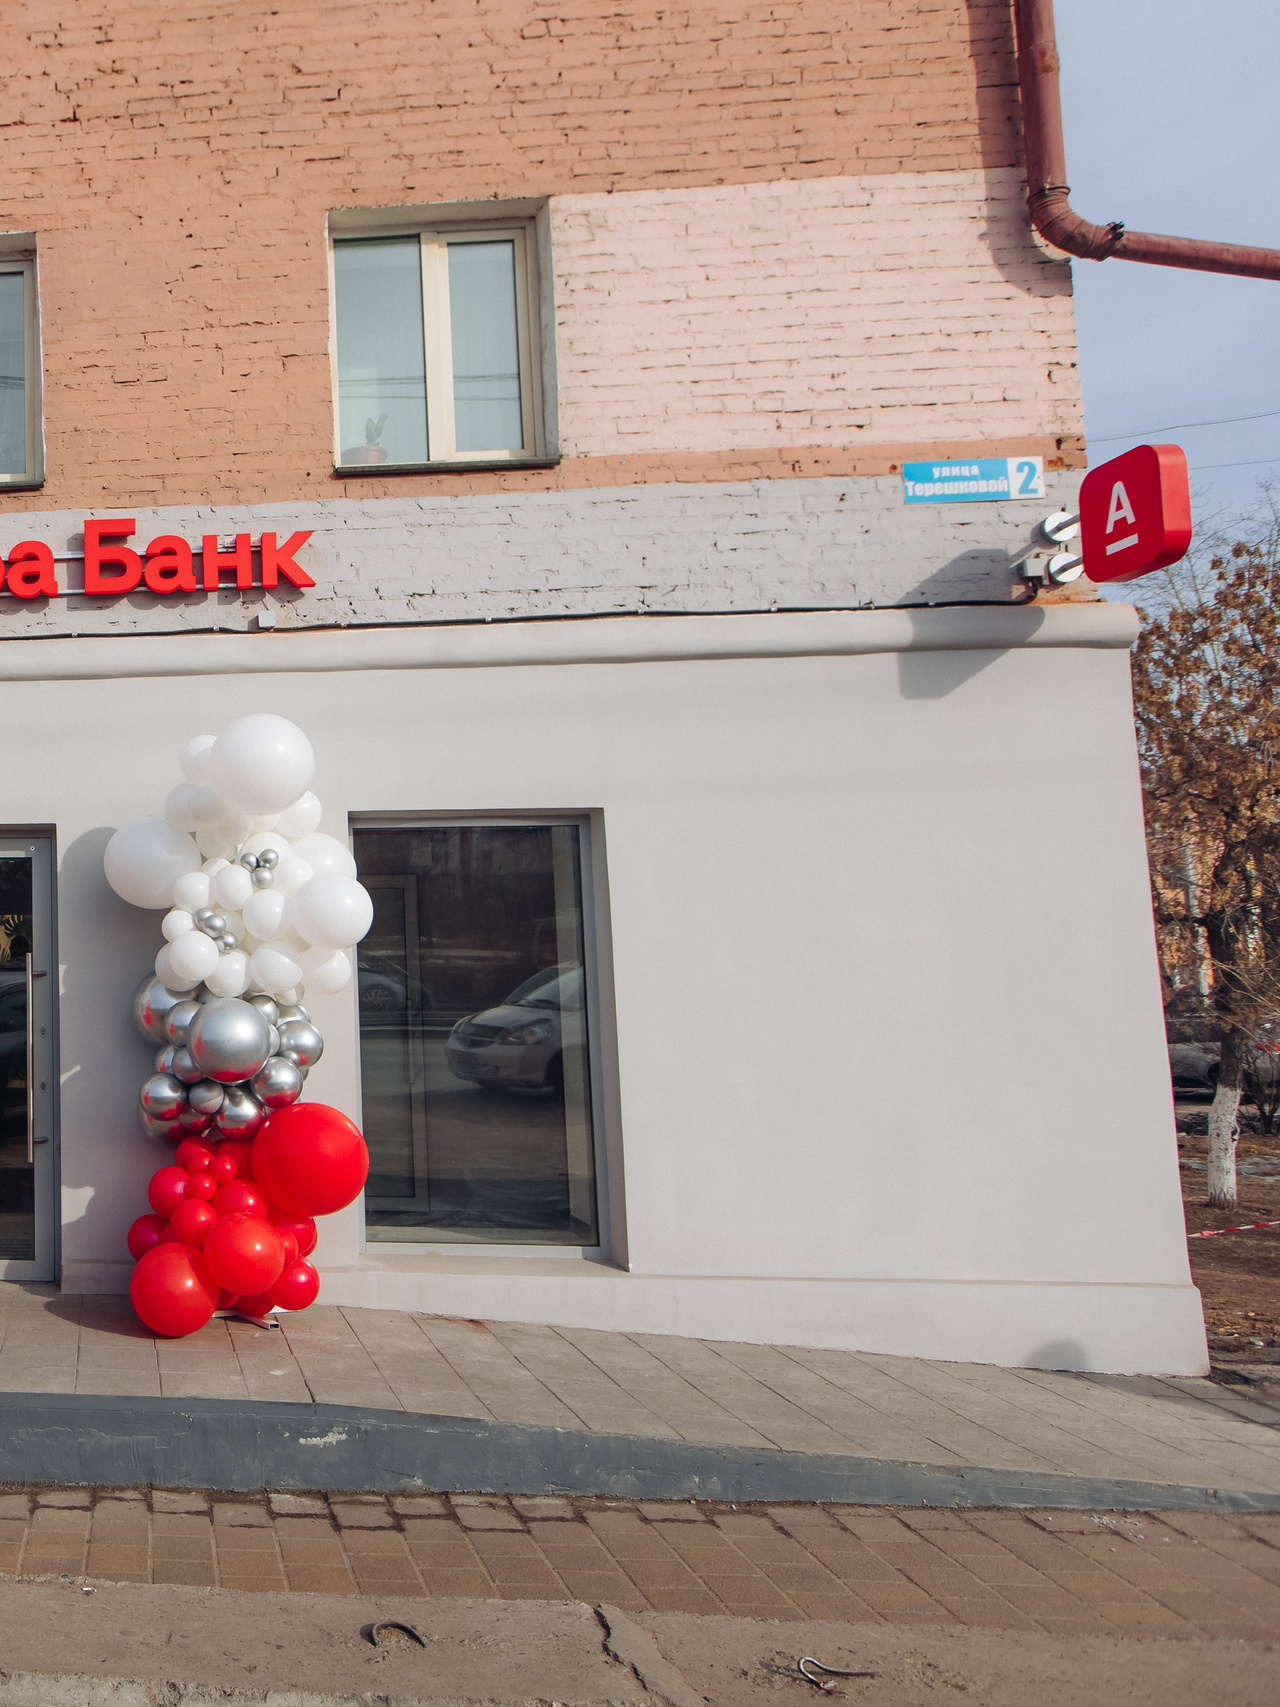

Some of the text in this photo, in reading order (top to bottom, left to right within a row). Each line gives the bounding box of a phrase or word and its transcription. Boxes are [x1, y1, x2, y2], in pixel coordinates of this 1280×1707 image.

[933, 465, 979, 478] улица
[1016, 461, 1039, 494] 2
[905, 477, 1008, 497] Терешковой
[85, 519, 318, 595] Банк
